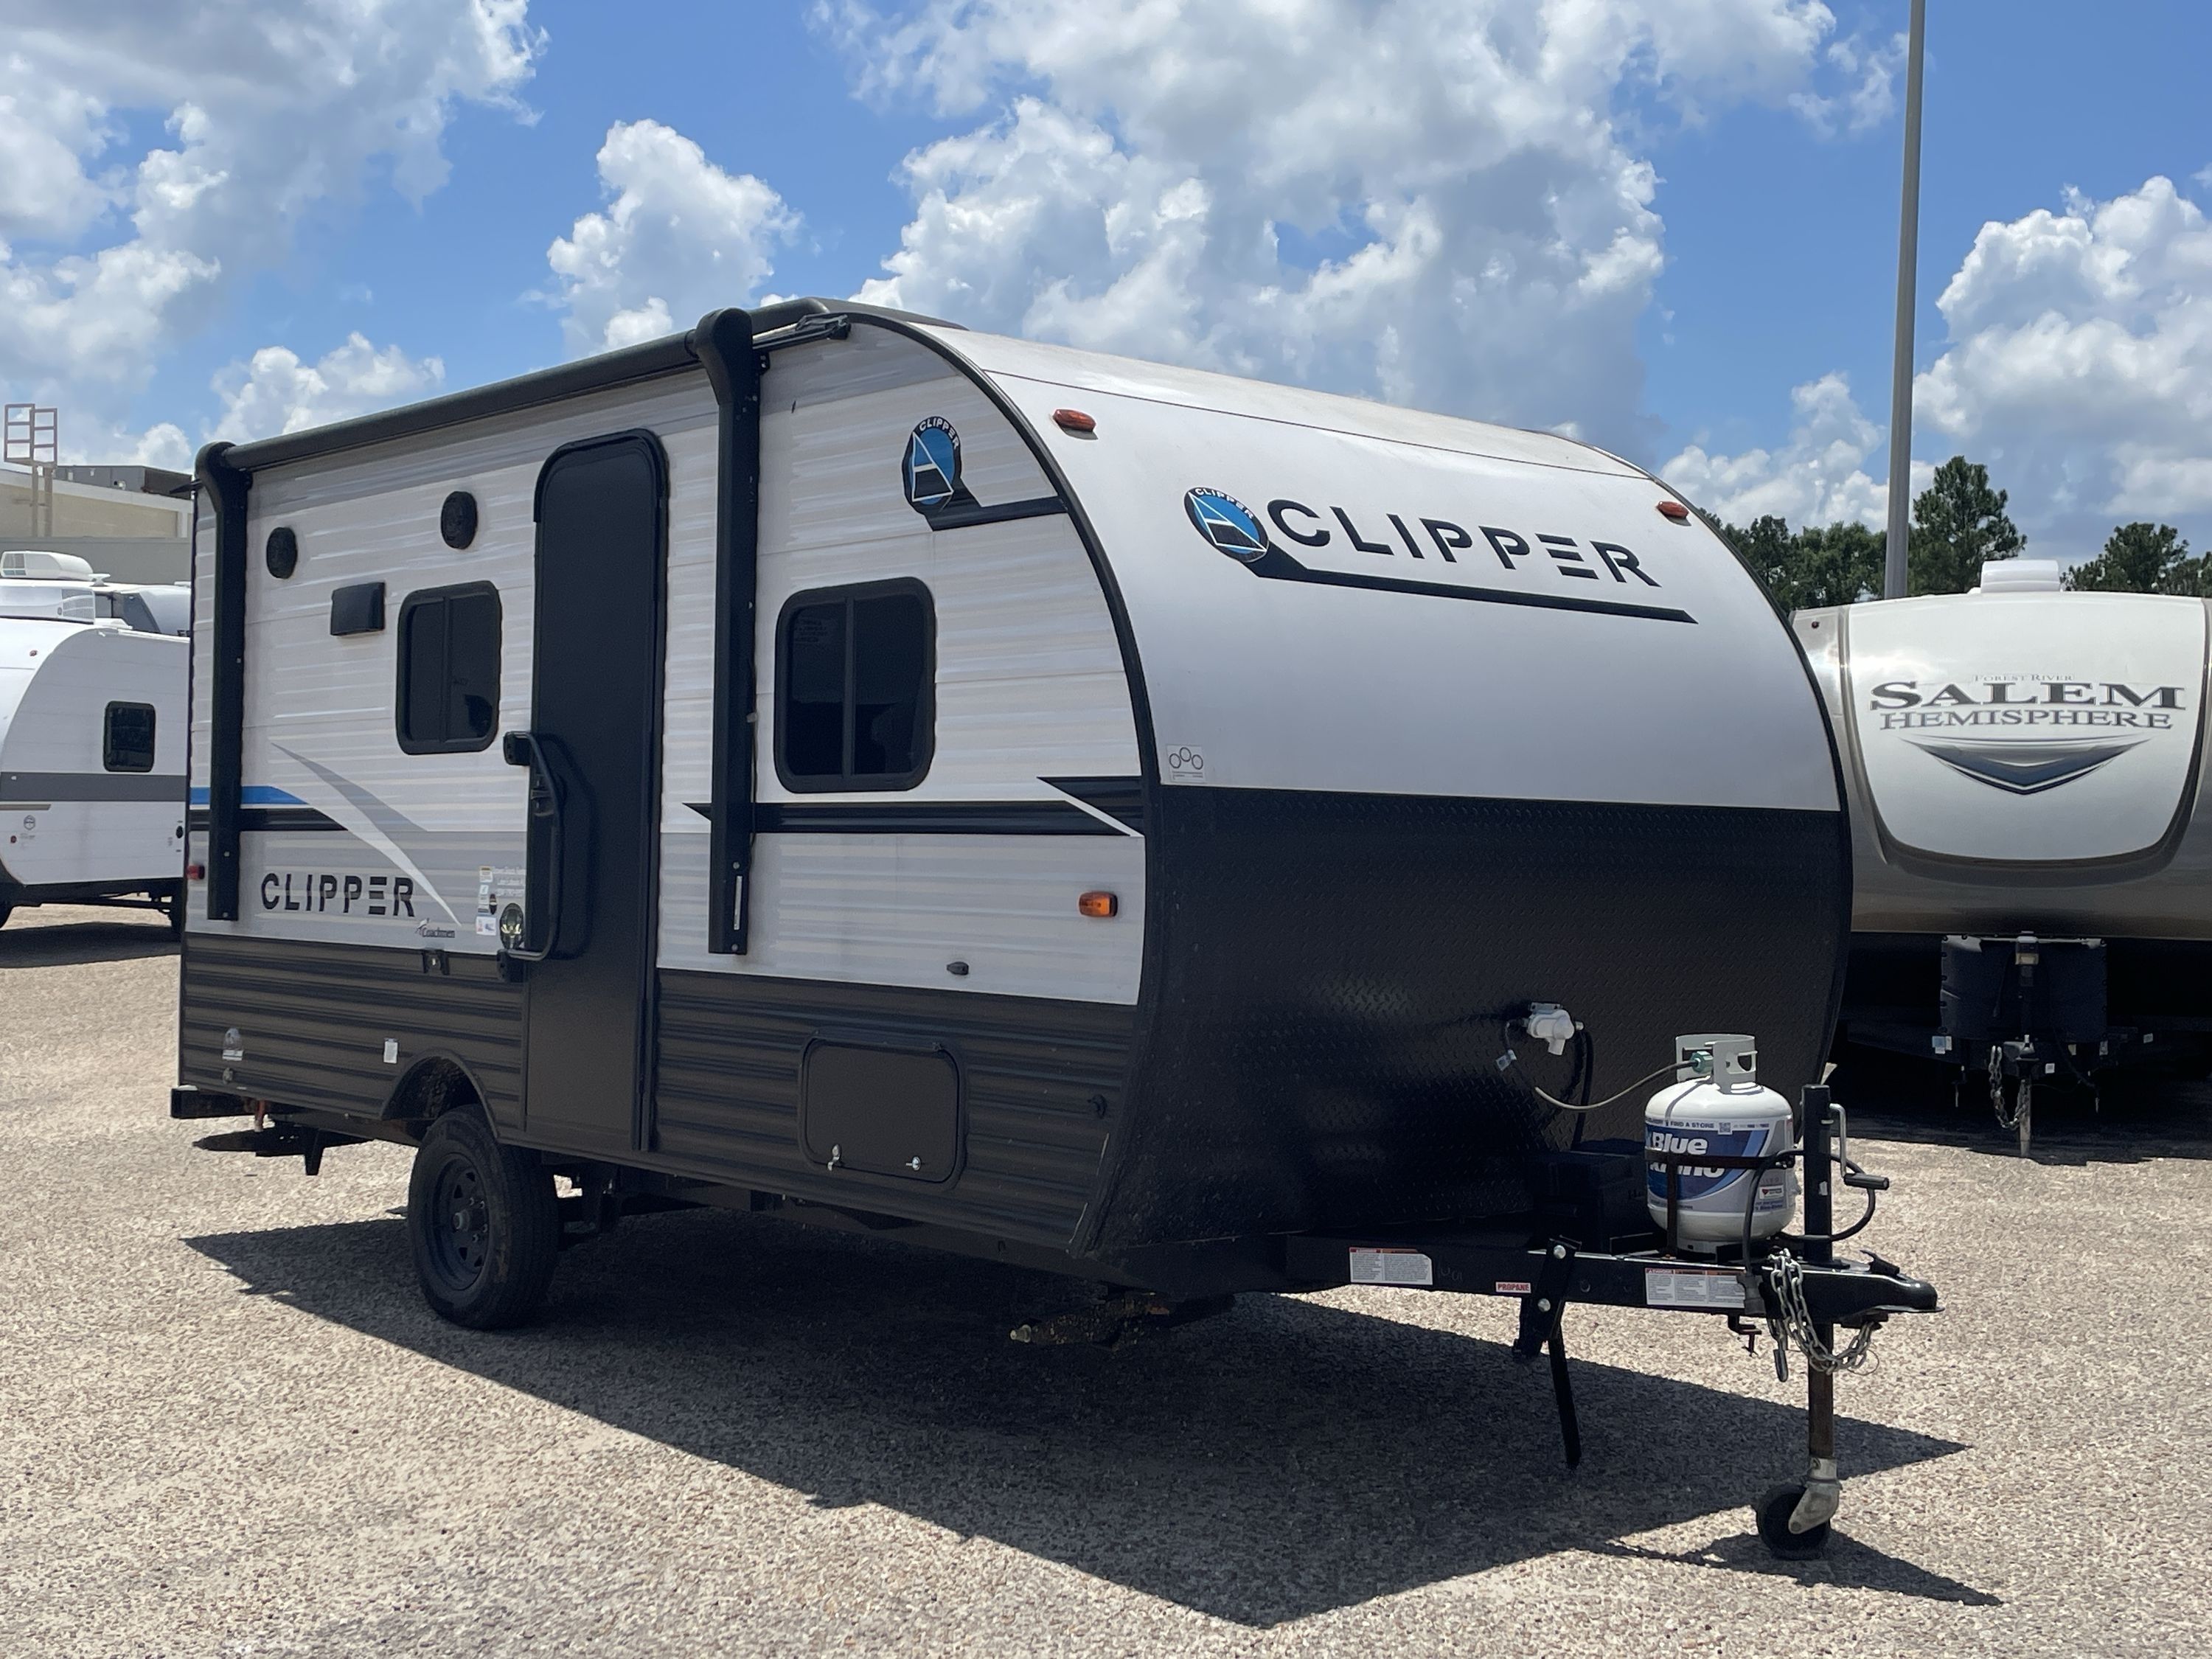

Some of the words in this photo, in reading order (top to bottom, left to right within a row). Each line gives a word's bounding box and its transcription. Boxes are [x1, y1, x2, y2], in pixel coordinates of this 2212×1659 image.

[919, 417, 959, 451] CLIPPER
[1194, 488, 1254, 519] CLIPPER
[1266, 499, 1662, 588] CLIPPER
[2031, 673, 2075, 682] RIVER
[1869, 681, 2187, 711] SALEM
[1879, 709, 2173, 730] HEMISPHERE
[261, 872, 416, 917] CLIPPER
[1652, 1131, 1708, 1155] Blue
[1498, 1283, 1530, 1292] PROPANE
